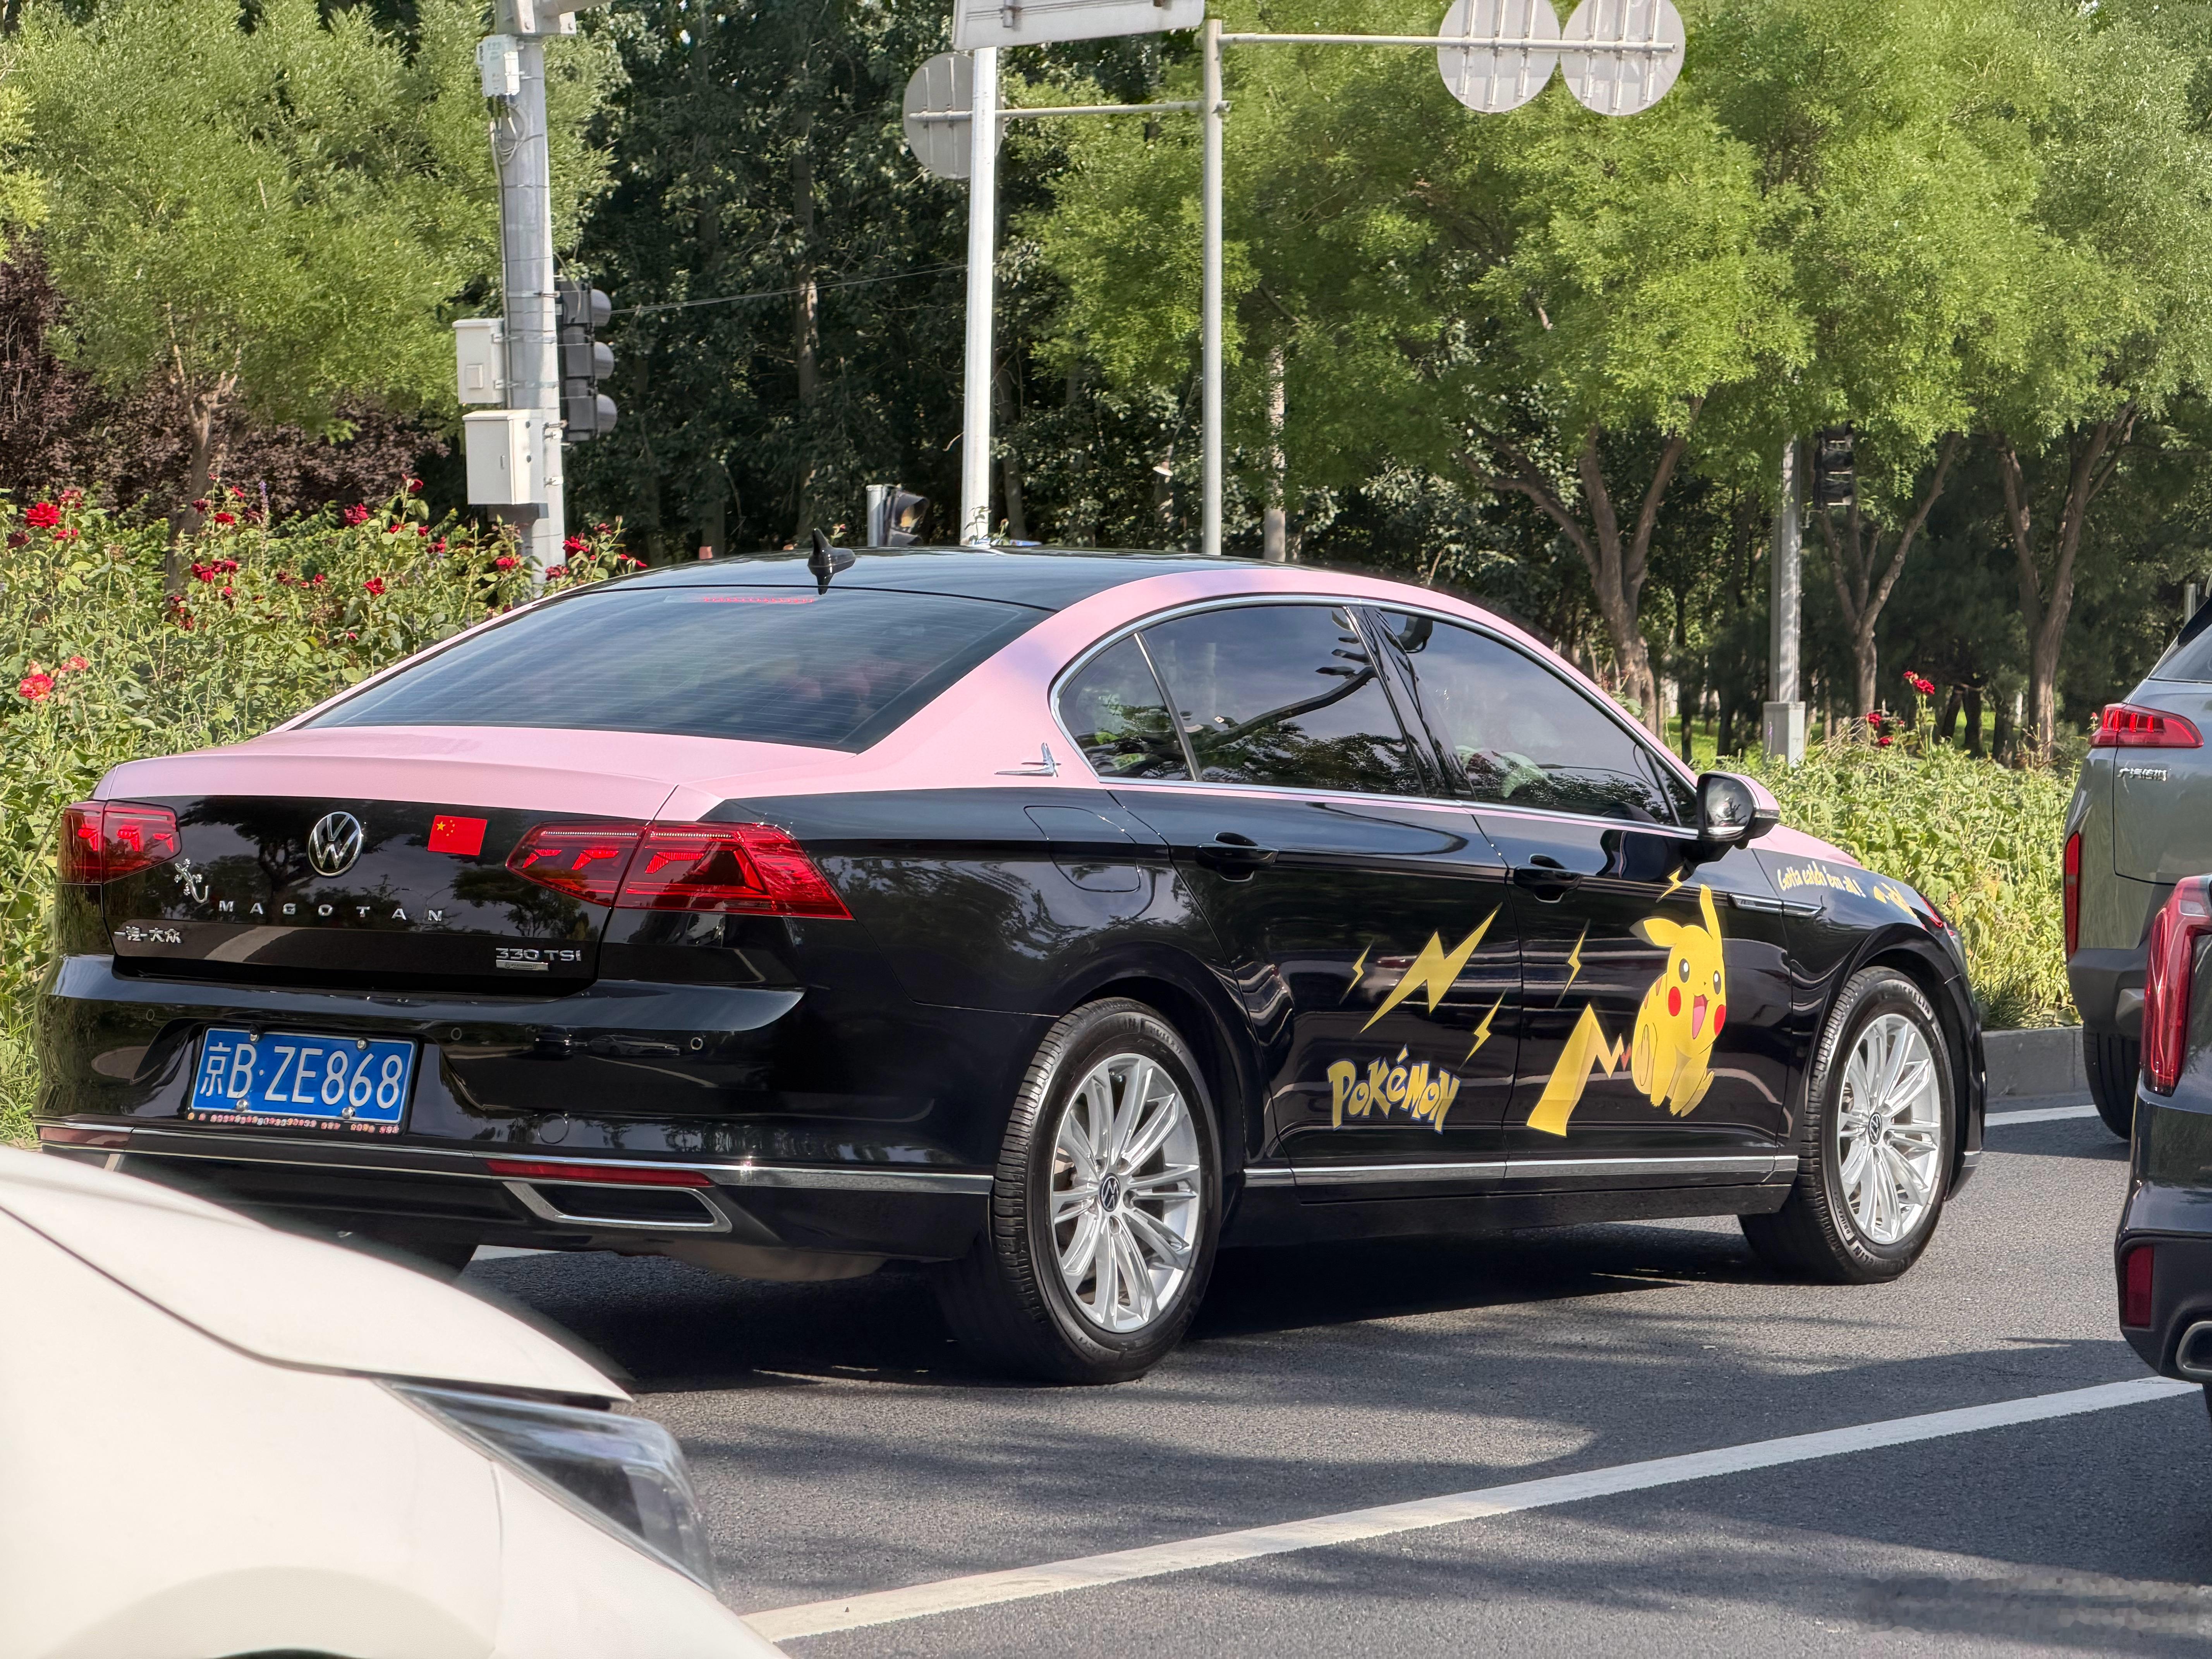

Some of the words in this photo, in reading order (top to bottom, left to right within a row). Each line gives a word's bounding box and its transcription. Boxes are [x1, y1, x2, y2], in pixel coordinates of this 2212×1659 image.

[219, 900, 442, 921] MAGOTAN
[496, 948, 539, 960] 330
[544, 950, 581, 961] TSI
